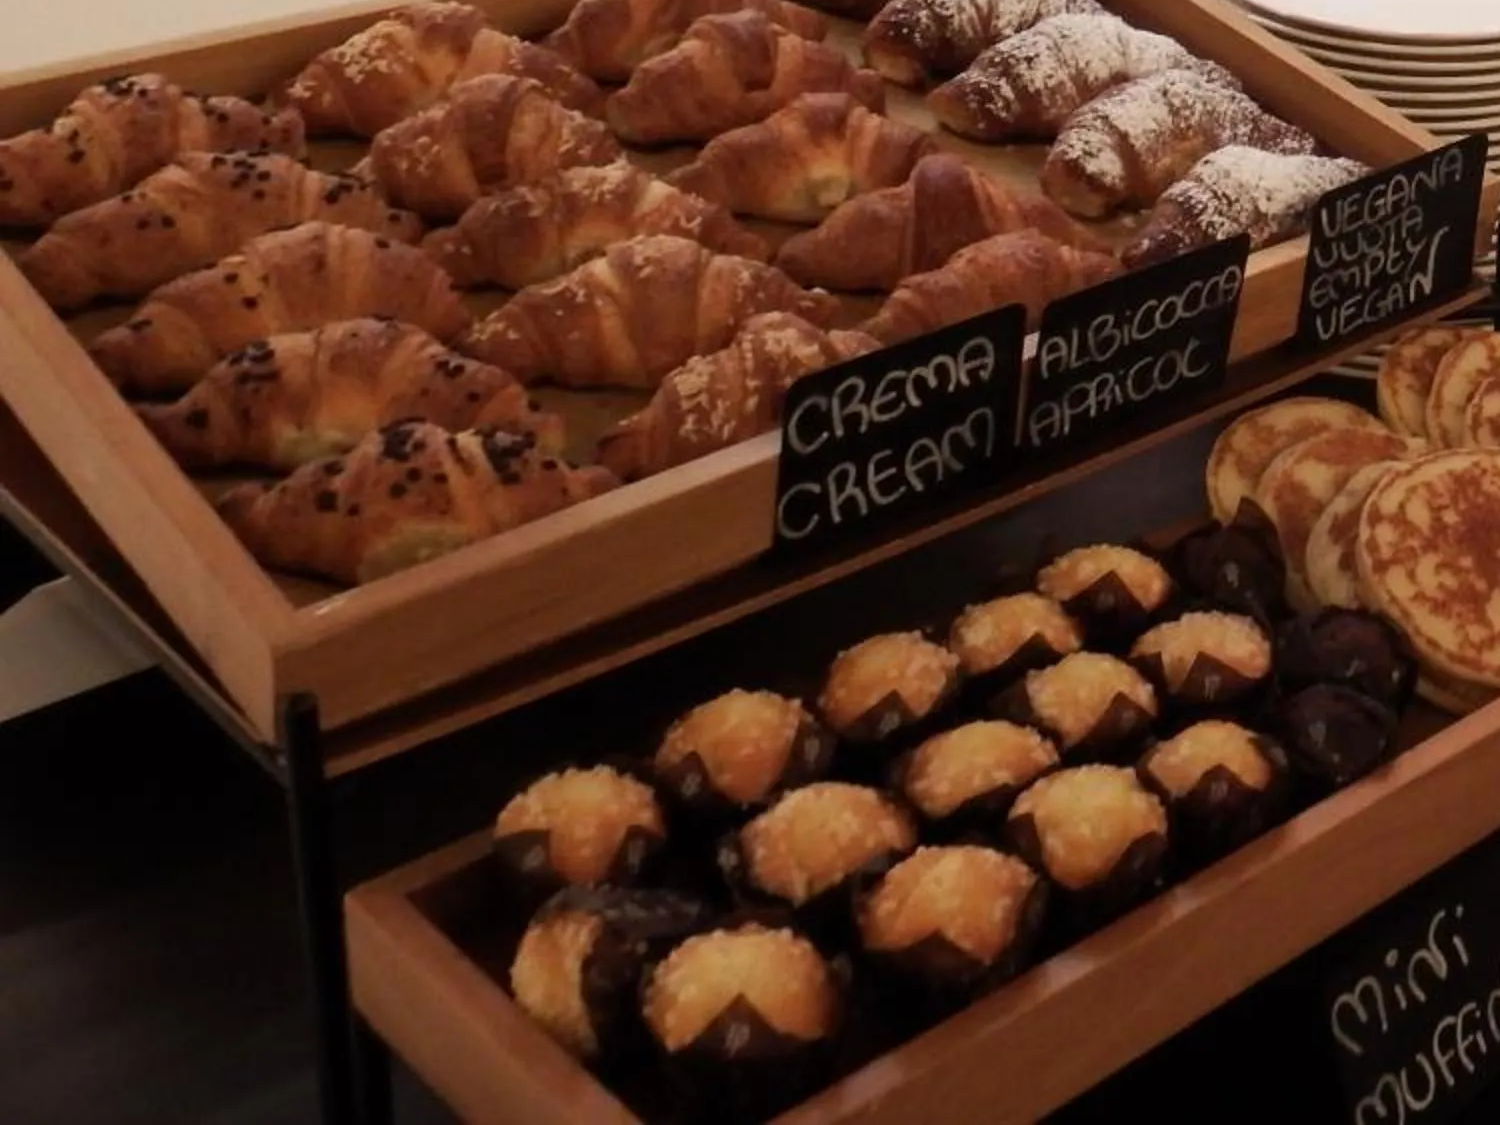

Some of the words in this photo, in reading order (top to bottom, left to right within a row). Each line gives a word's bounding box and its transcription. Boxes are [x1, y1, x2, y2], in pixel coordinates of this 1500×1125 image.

[1321, 148, 1463, 238] VEGANA
[1315, 226, 1450, 341] VEGAN
[788, 336, 995, 454] CREMA
[778, 407, 995, 539] CREAM
